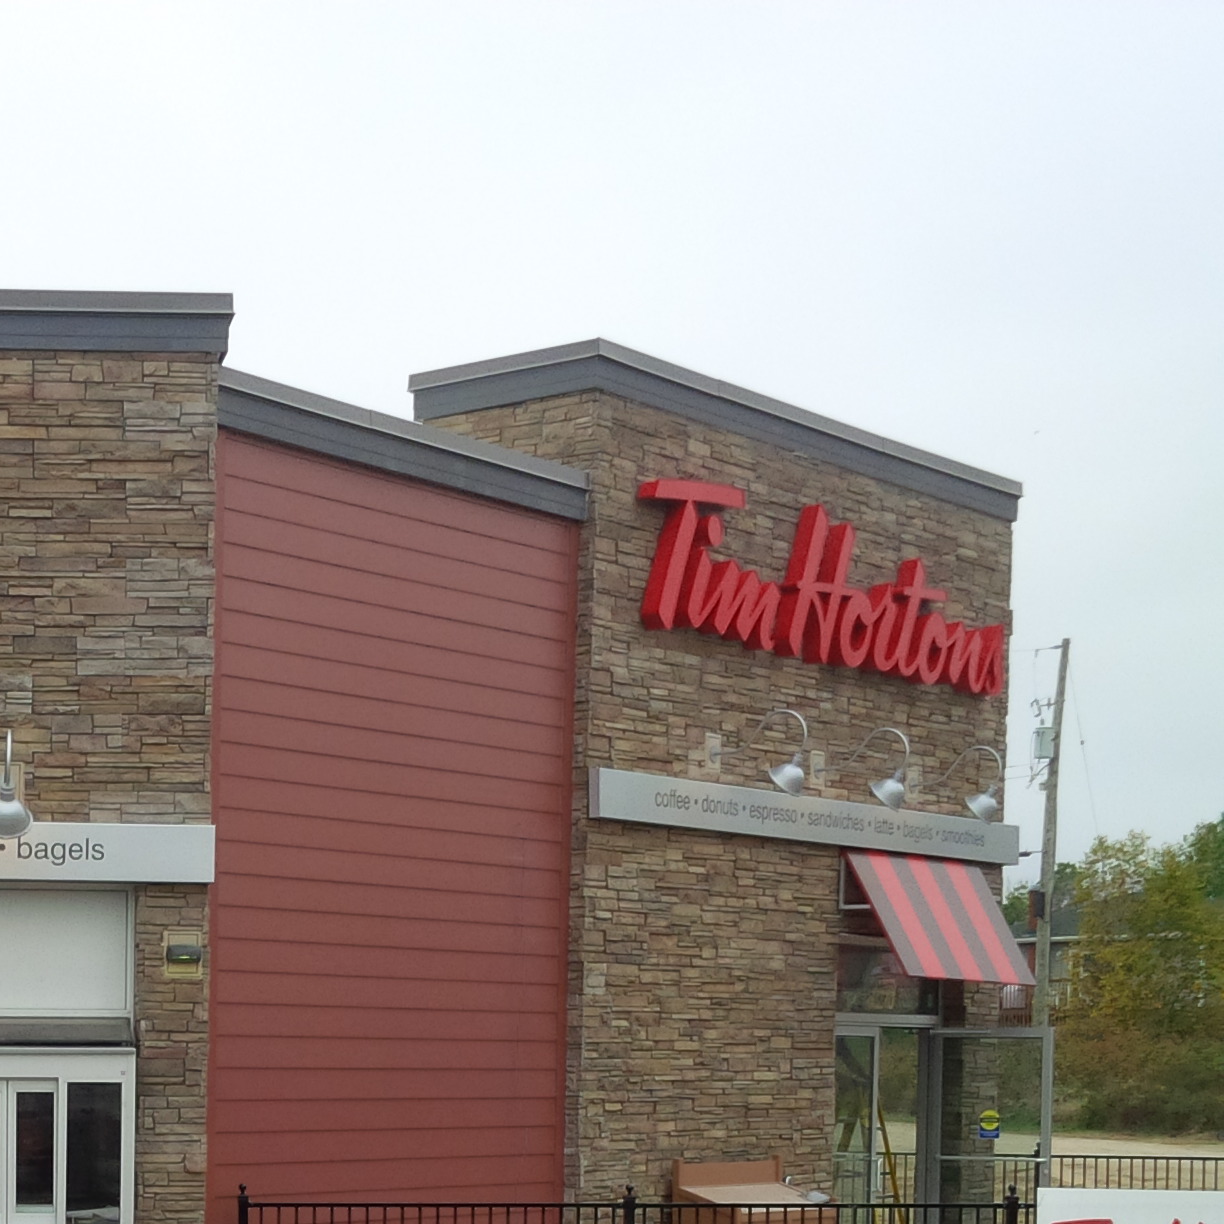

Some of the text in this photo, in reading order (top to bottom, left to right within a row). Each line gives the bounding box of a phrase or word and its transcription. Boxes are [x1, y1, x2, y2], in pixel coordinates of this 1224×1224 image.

[638, 477, 1004, 697] Tim Hortons
[654, 788, 985, 847] coffee donuts espresso sandwiches latte bagels smoothies
[16, 836, 106, 867] bagels
